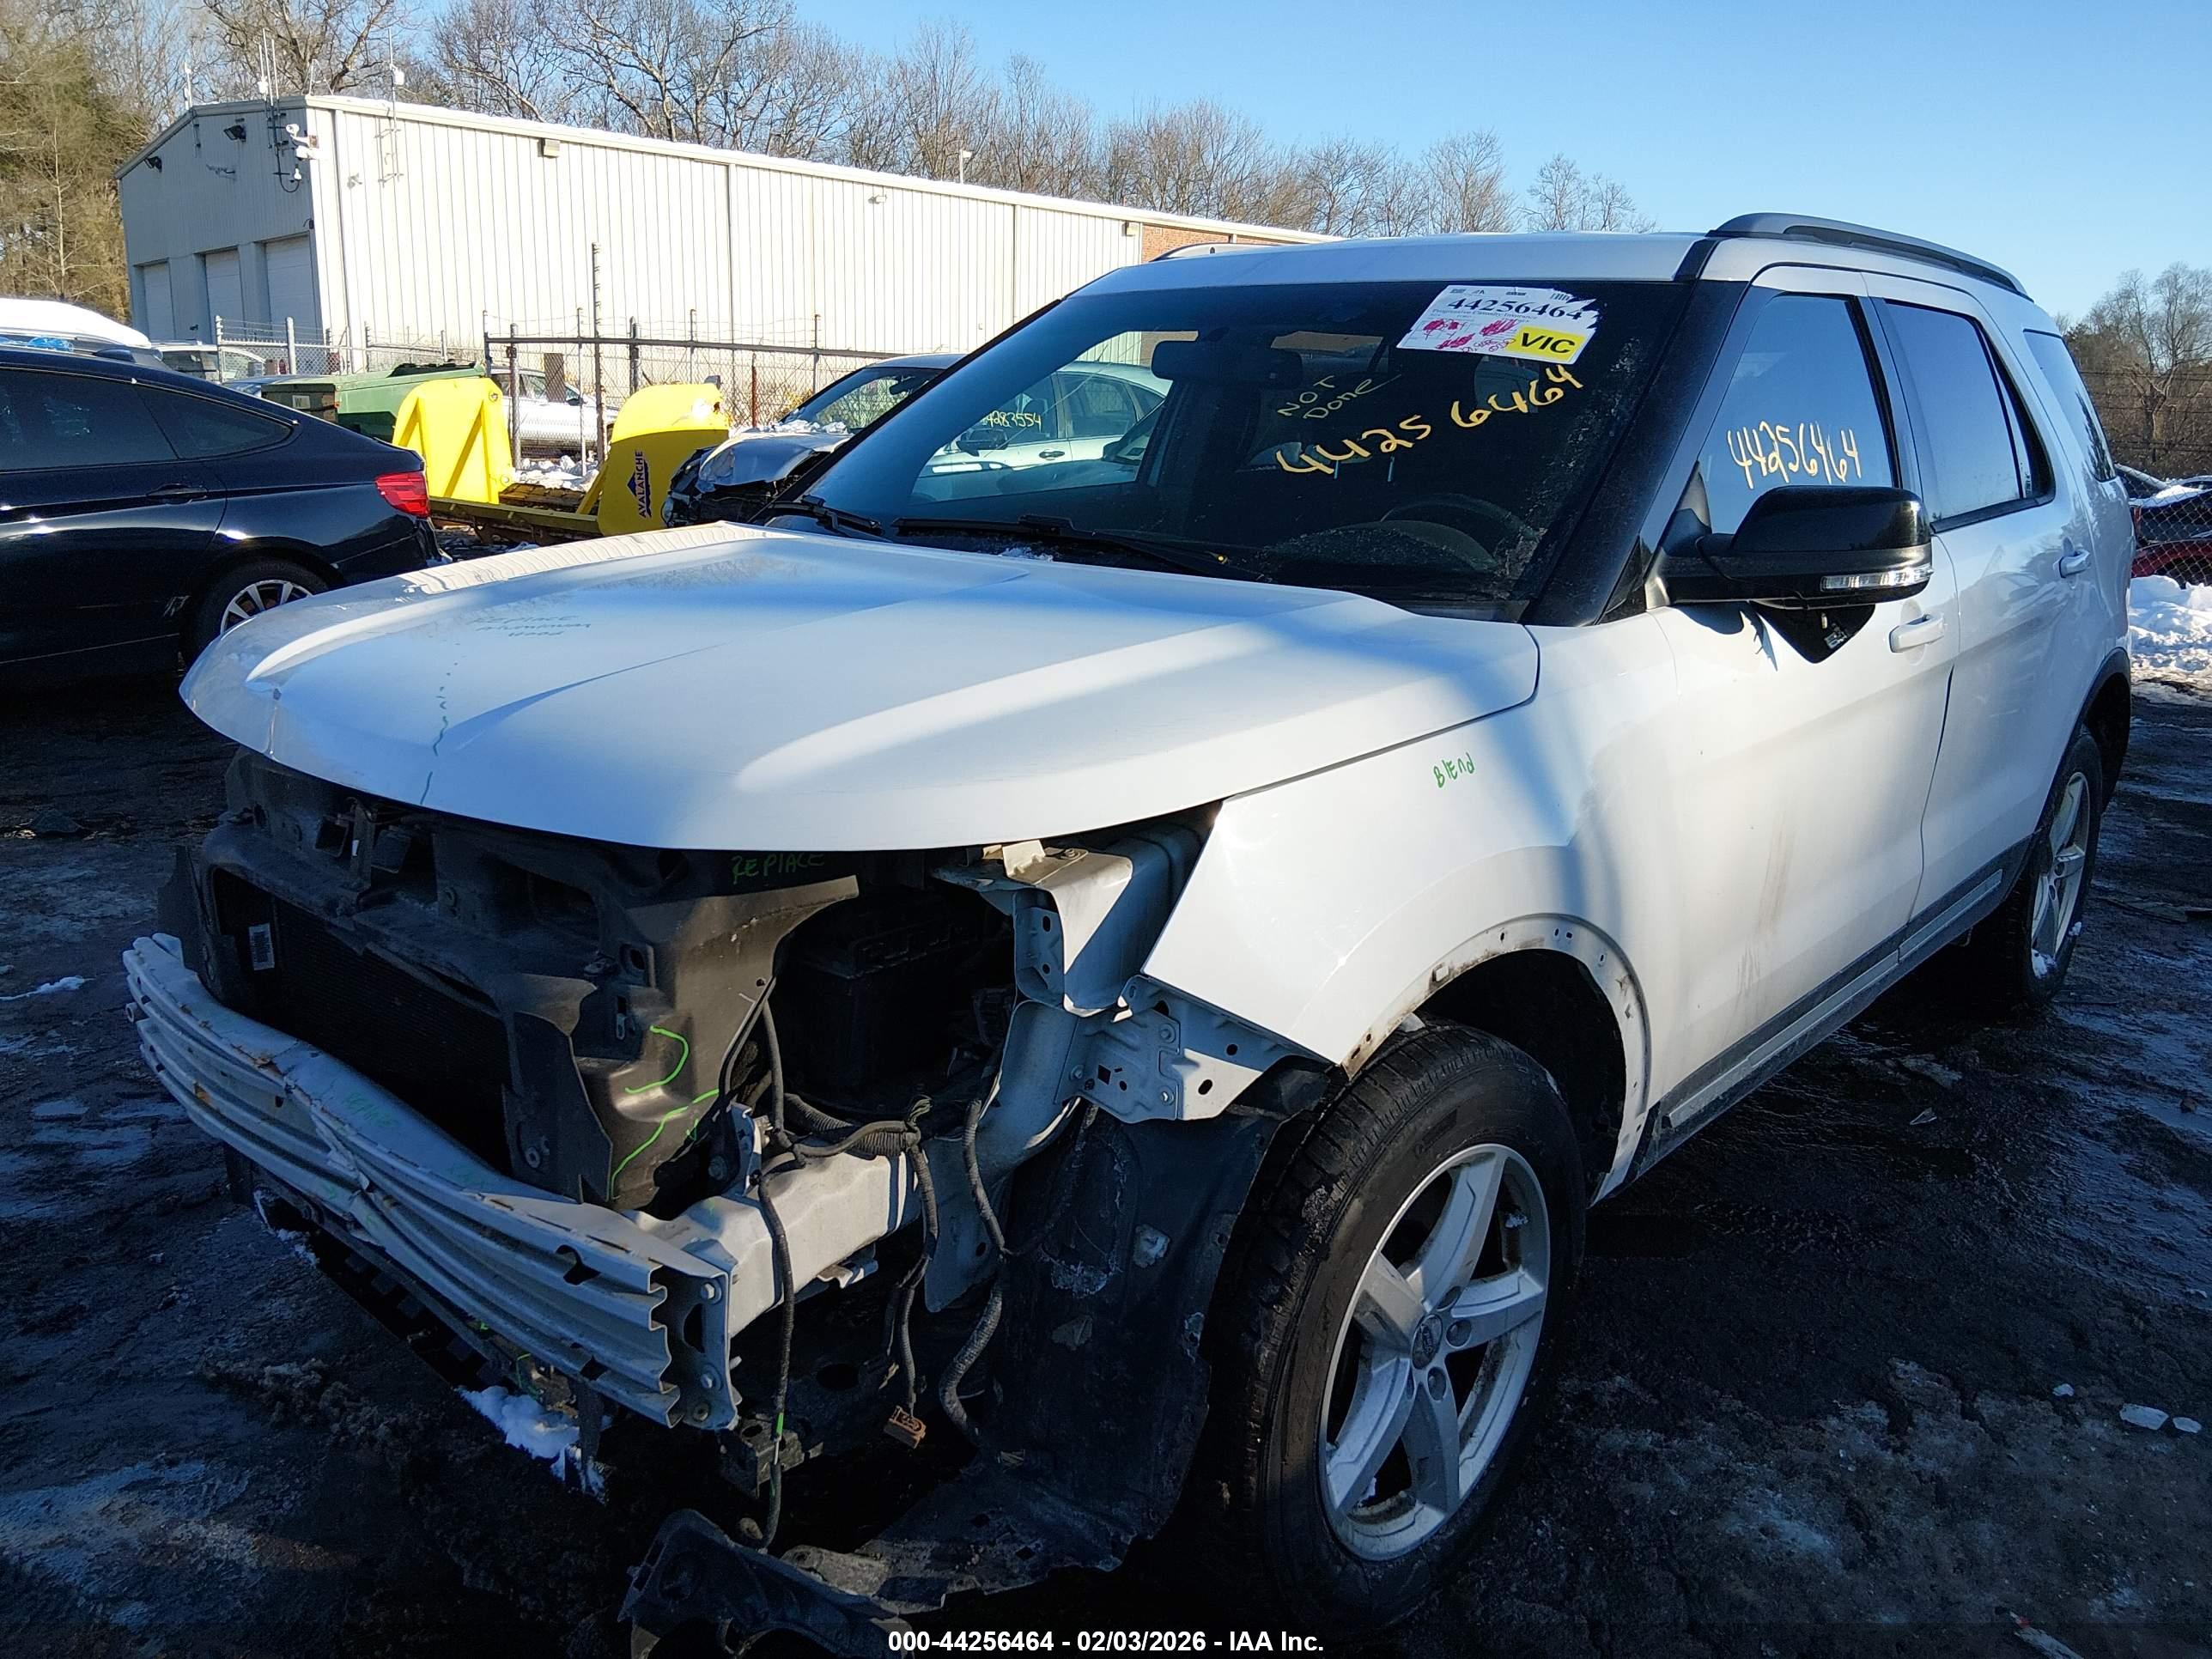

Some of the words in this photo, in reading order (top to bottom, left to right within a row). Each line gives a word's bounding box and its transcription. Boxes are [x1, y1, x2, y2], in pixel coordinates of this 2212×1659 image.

[1448, 297, 1583, 321] 44256464
[1521, 331, 1576, 355] VIC
[1277, 374, 1335, 416] NOT
[1303, 374, 1401, 419] Done
[1727, 420, 1862, 489] 44256464
[635, 450, 647, 519] AVALANCHE
